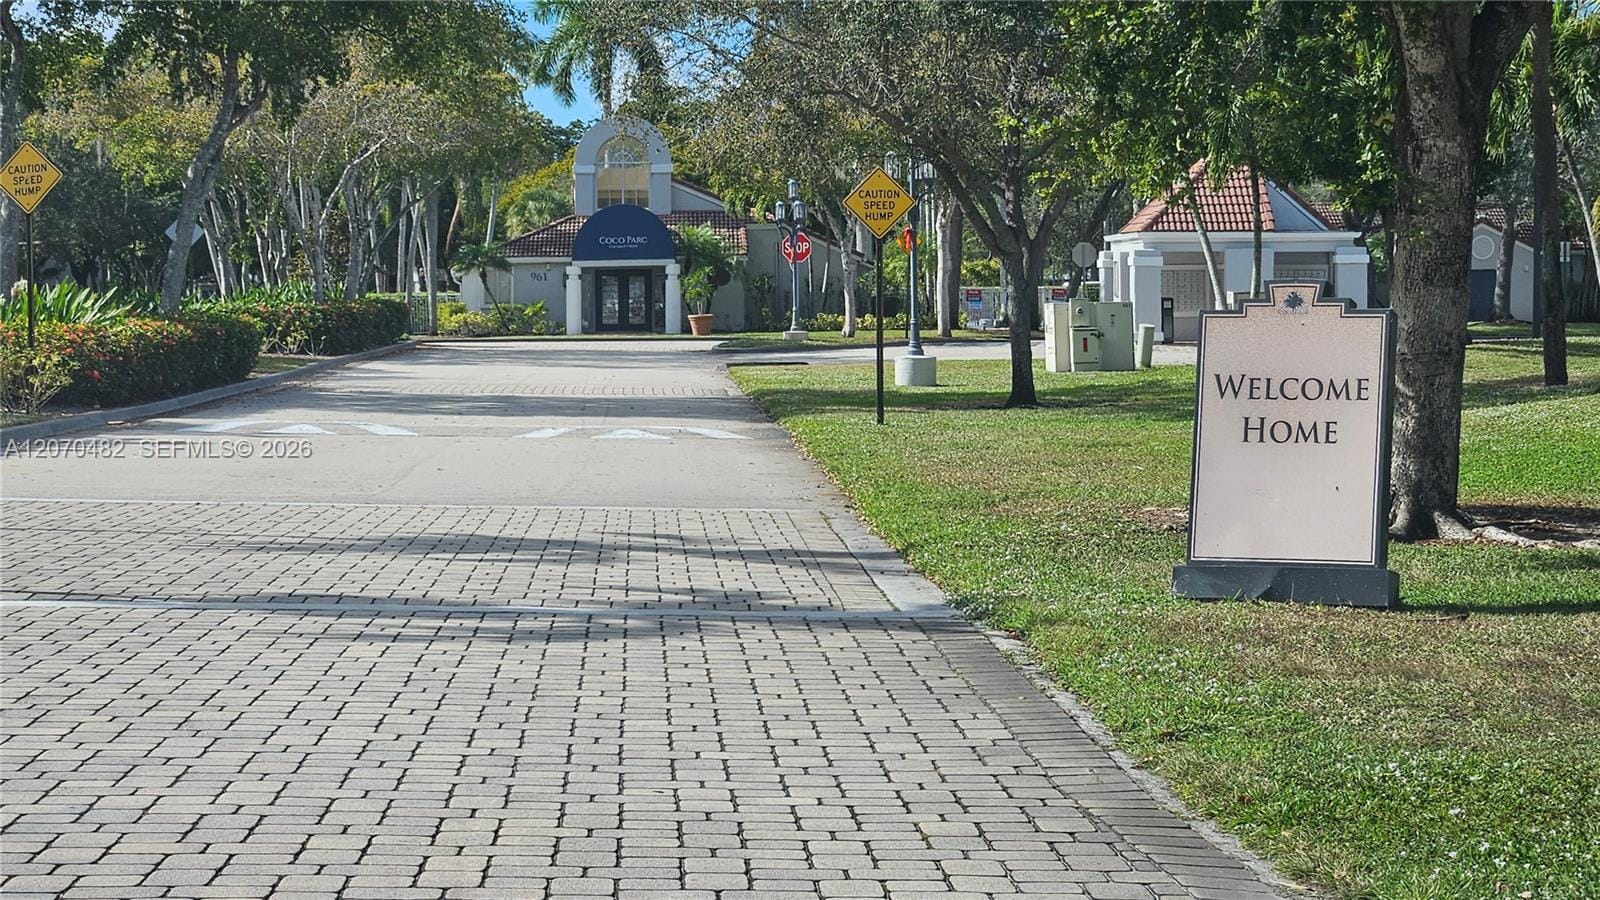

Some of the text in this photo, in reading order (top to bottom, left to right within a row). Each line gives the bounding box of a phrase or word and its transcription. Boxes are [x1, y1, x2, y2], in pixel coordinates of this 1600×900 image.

[8, 163, 47, 174] CAUTION
[13, 175, 43, 185] SPEED
[15, 187, 41, 196] HUMP
[858, 190, 900, 199] CAUTION
[864, 201, 895, 210] SPEED
[865, 212, 893, 221] HUMP
[599, 235, 648, 245] COCO PARC
[785, 242, 809, 253] SOP
[530, 272, 547, 282] 961
[1214, 373, 1370, 401] WELCOME
[1241, 416, 1338, 444] HOME
